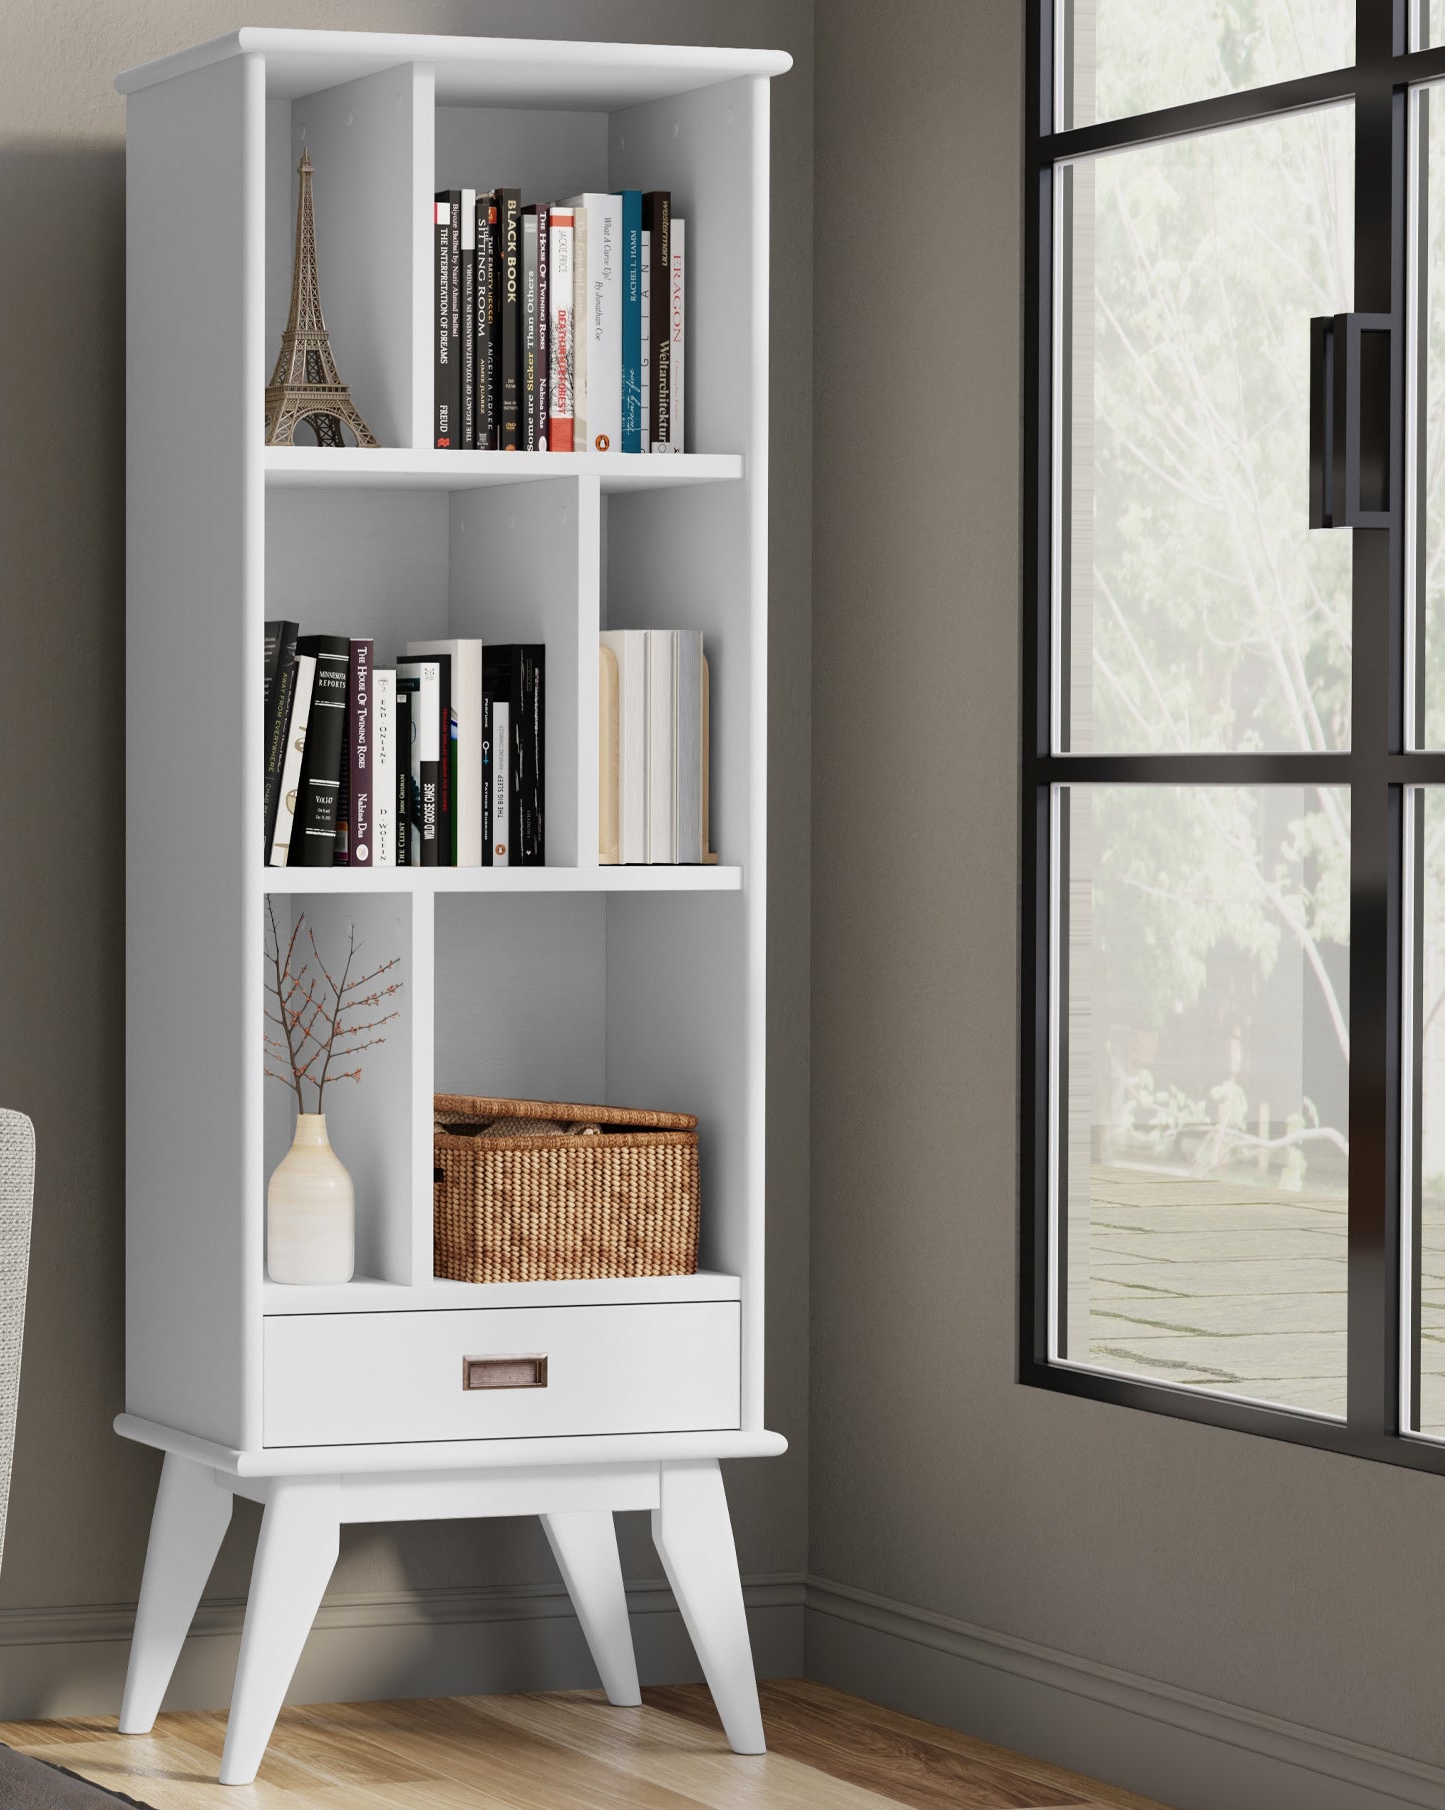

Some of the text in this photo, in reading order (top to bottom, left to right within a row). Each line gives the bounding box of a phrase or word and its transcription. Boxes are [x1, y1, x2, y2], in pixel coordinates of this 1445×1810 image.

[508, 200, 516, 303] BLACK BOOK
[559, 230, 567, 272] JACKIE PRICE
[594, 281, 603, 289] By
[602, 267, 611, 280] Up!
[440, 228, 448, 364] THE INTERPRETATION OF DREAMS
[466, 304, 472, 312] IN
[673, 255, 682, 342] ERAGON
[466, 384, 472, 394] OF
[659, 340, 669, 442] Weltarchitektur
[440, 405, 448, 432] FREUD
[319, 671, 346, 681] MINNESOTA
[319, 680, 346, 689] REPORTS
[358, 647, 367, 768] THE HOUSE OF TWINING ROSES
[268, 721, 280, 772] EVERYWHERE
[358, 793, 367, 838] Nabina Das
[424, 784, 435, 839] WILD GOOSE CHASE
